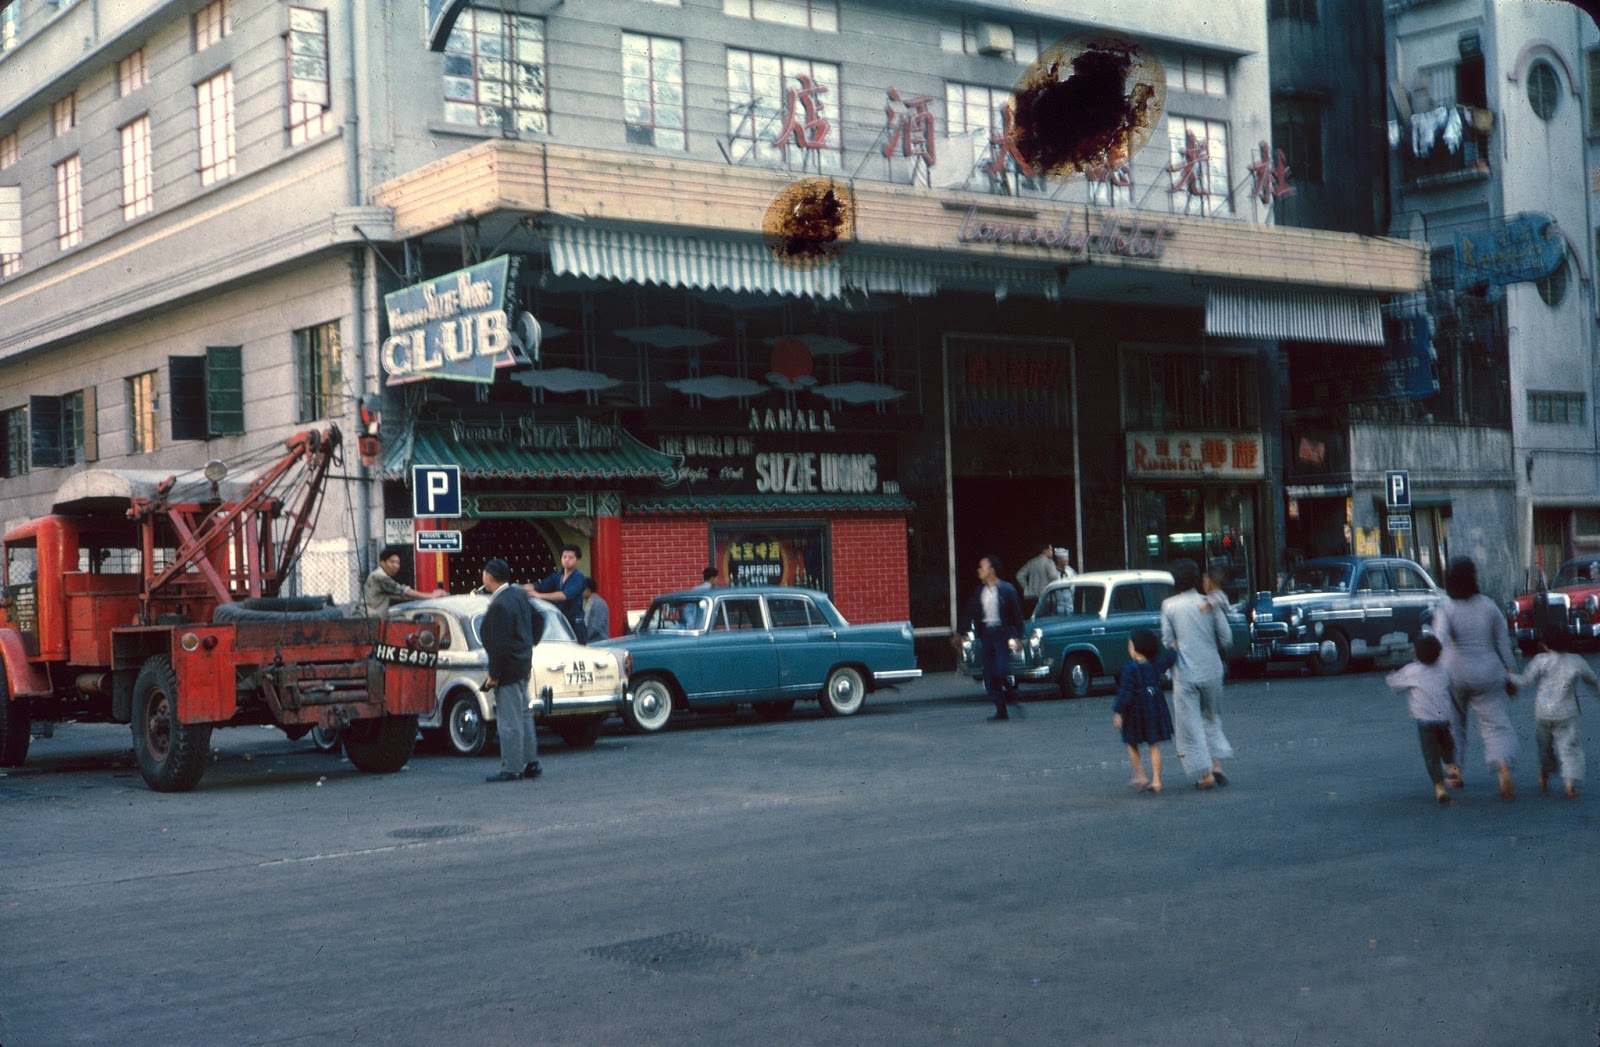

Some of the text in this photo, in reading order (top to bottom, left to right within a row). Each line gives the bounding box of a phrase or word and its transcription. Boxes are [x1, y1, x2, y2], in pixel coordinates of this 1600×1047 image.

[381, 310, 511, 375] CLUB
[755, 453, 877, 494] SUZIE WONG
[427, 471, 448, 512] P
[1392, 475, 1404, 507] P
[738, 564, 780, 577] SAPPORO
[377, 644, 396, 661] HK
[566, 671, 593, 684] 7753
